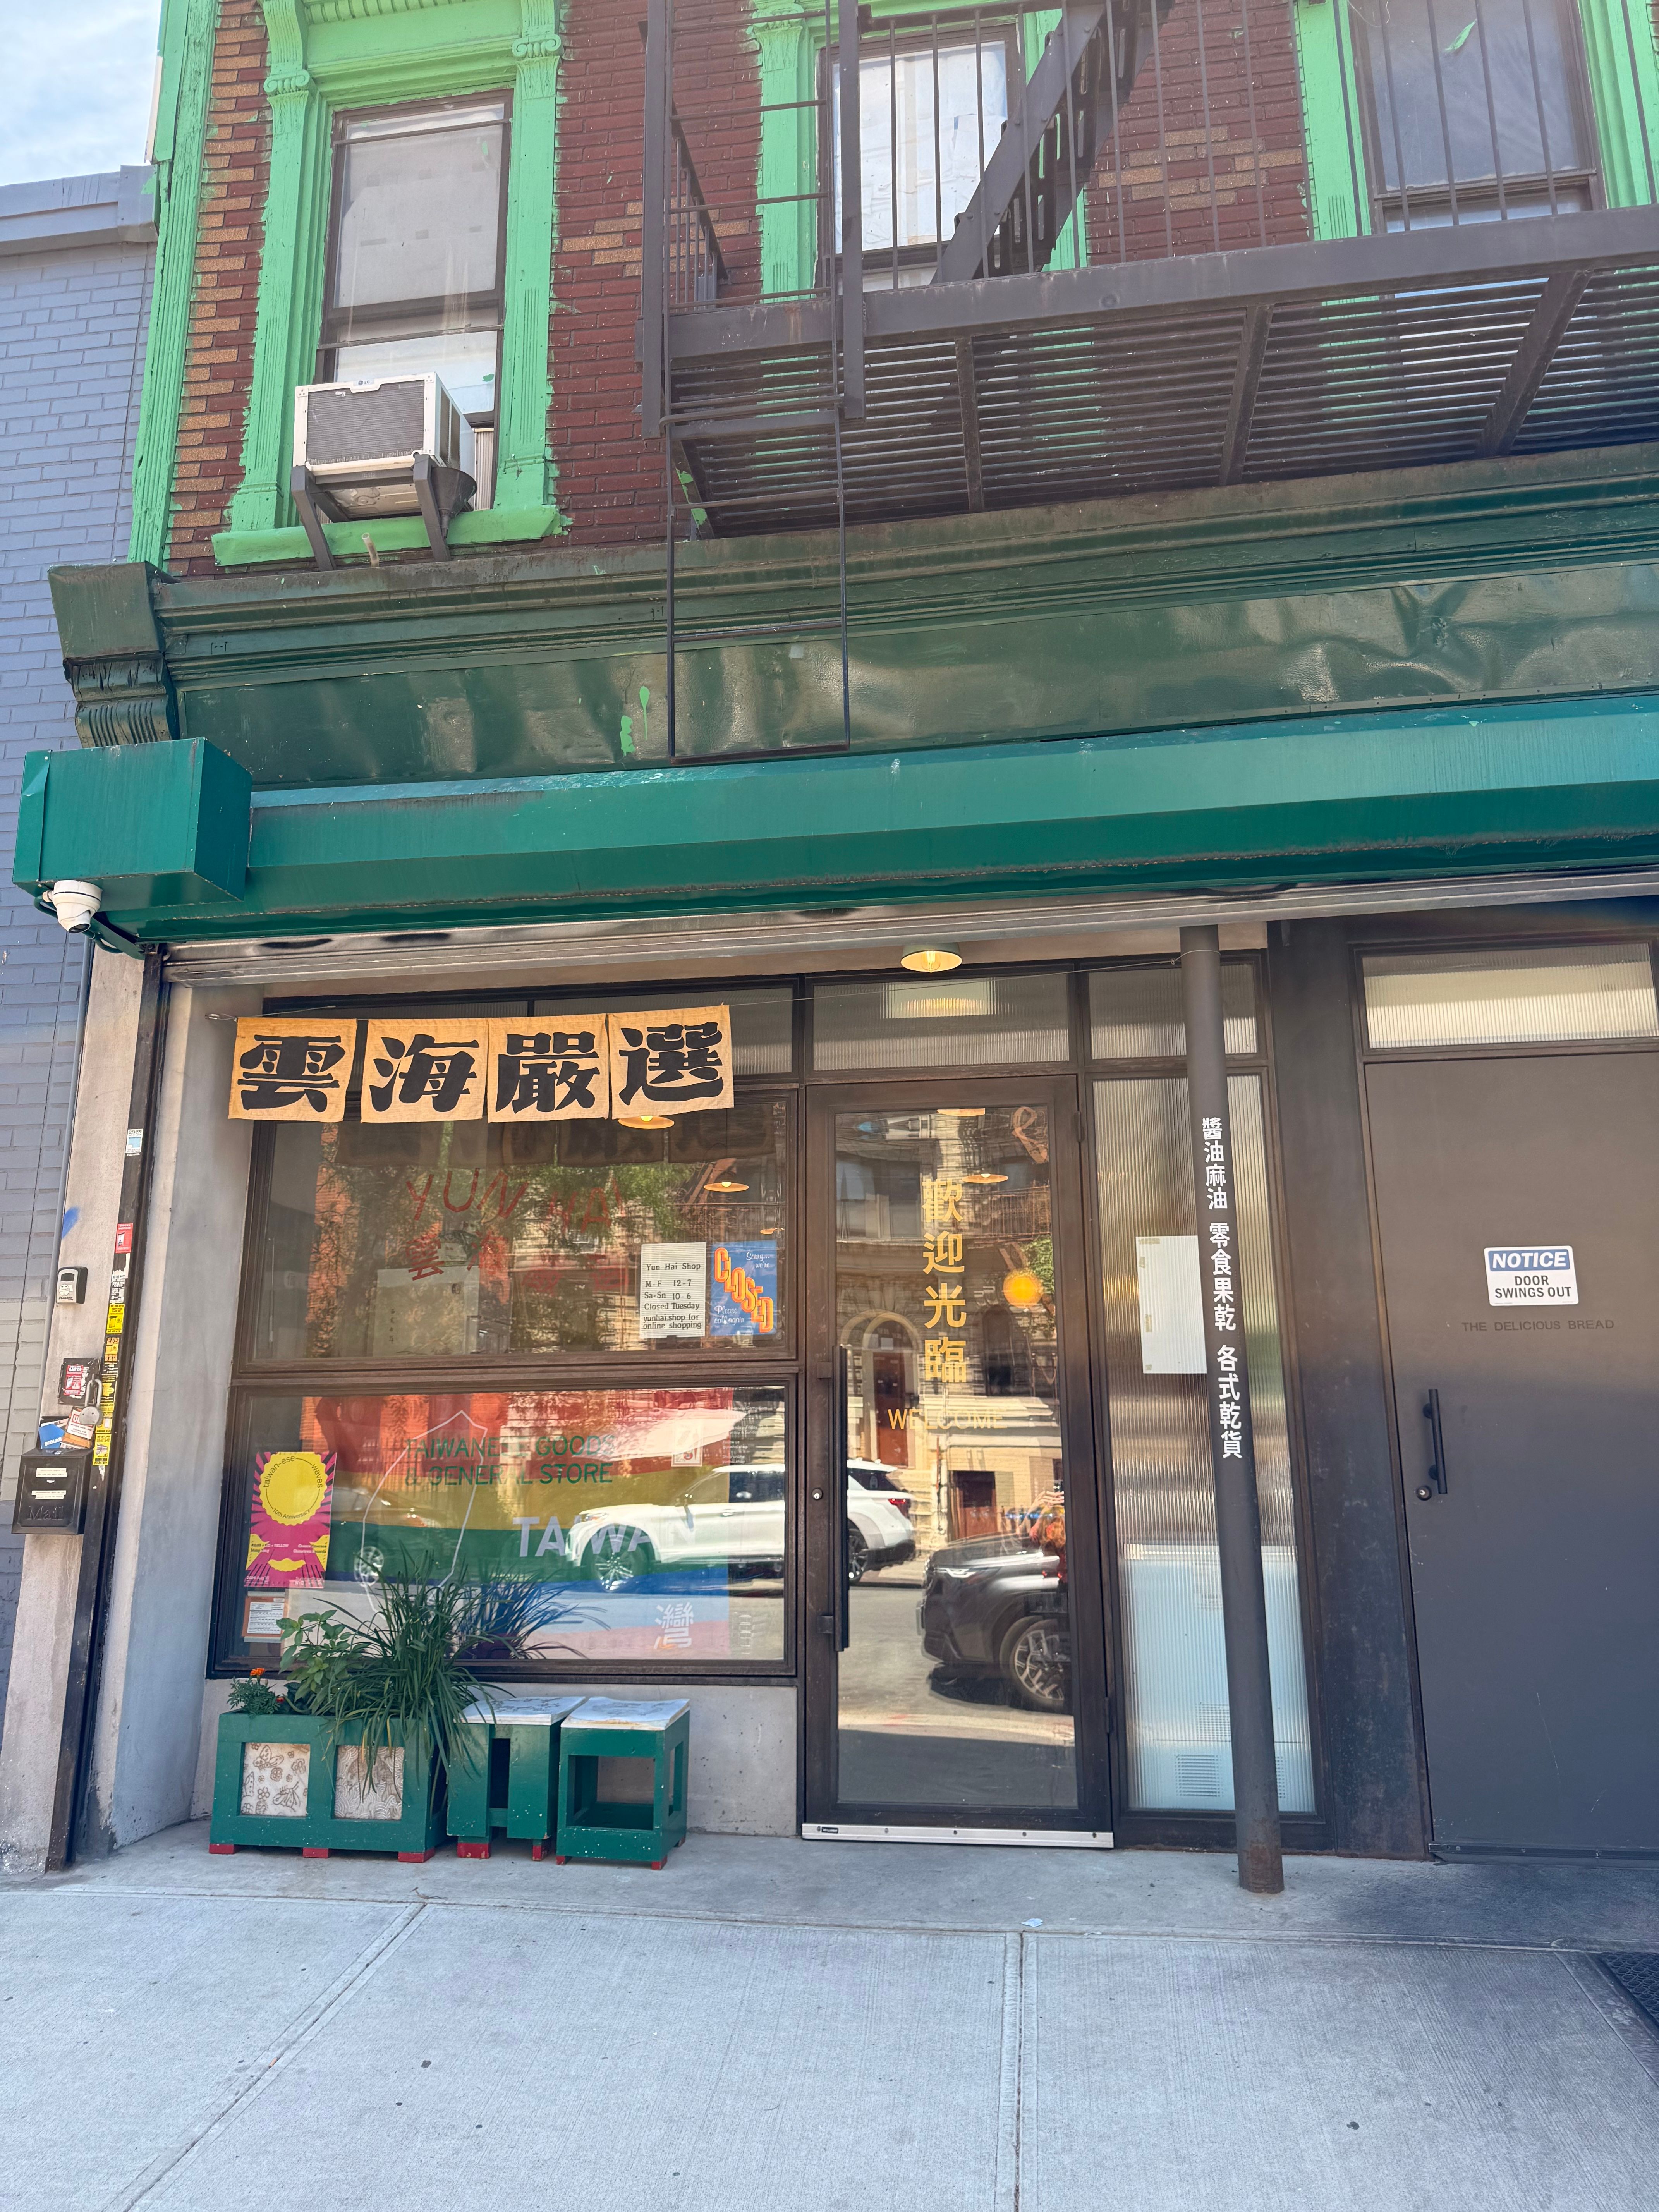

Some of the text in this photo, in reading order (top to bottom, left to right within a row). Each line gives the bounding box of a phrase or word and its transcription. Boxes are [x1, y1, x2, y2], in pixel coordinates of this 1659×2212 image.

[237, 1021, 725, 1113] 雲海嚴選
[1201, 1116, 1228, 1210] 醬油麻油
[405, 1168, 530, 1221] YUN
[682, 1262, 701, 1271] Shop
[1492, 1251, 1567, 1269] NOTICE
[921, 1179, 967, 1383] 歡迎光臨
[1209, 1222, 1236, 1331] 零食果乾
[1514, 1275, 1549, 1286] DOOR
[714, 1247, 774, 1333] CLOSED
[1494, 1286, 1571, 1298] SWINGS OUT
[671, 1302, 700, 1310] Tuesday
[1462, 1319, 1614, 1332] THE DELICIOUS BREAD
[1216, 1344, 1243, 1459] 各式乾貨
[888, 1408, 1008, 1430] WELCOME
[535, 1434, 615, 1457] GOODS
[263, 1455, 323, 1488] taiwan-ese waves
[429, 1464, 533, 1486] GENERAL
[539, 1463, 613, 1484] STORE
[273, 1508, 310, 1519] 10th Anniversary
[653, 1601, 694, 1650] 灣
